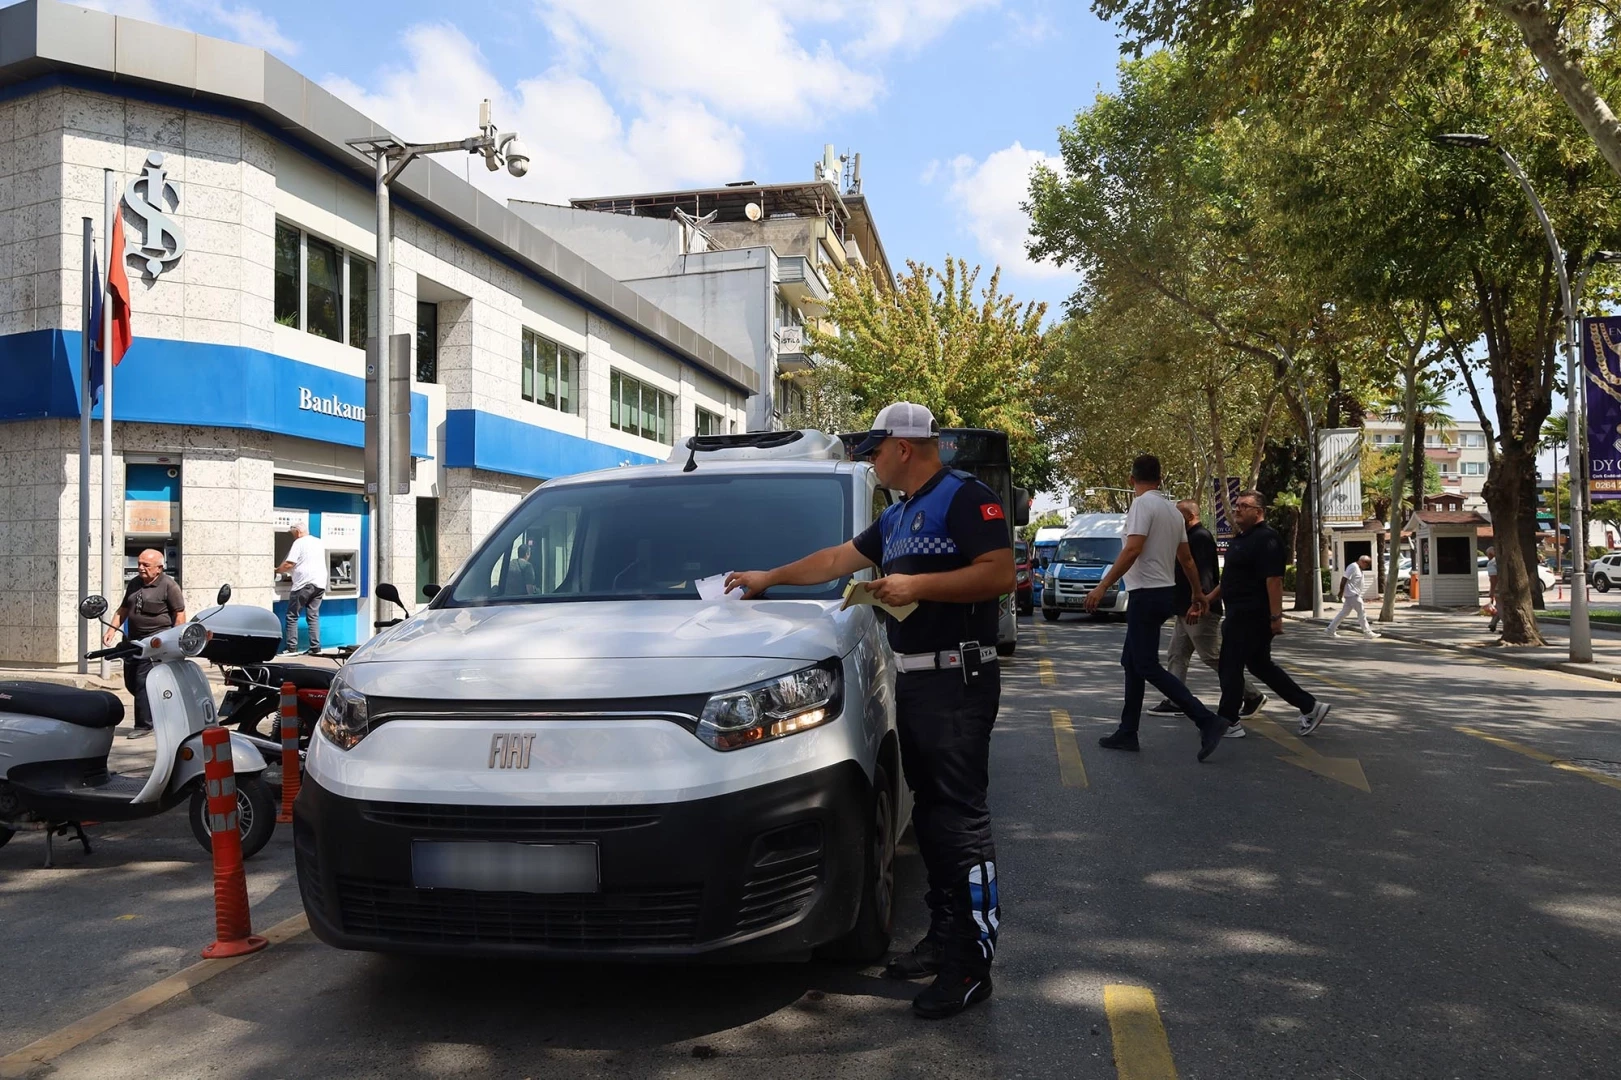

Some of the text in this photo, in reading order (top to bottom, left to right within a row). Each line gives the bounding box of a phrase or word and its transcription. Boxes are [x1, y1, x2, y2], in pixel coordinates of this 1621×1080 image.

[299, 386, 366, 422] Bankam
[1592, 459, 1614, 471] DY
[1595, 481, 1616, 489] 0264
[488, 733, 536, 769] FIAT
